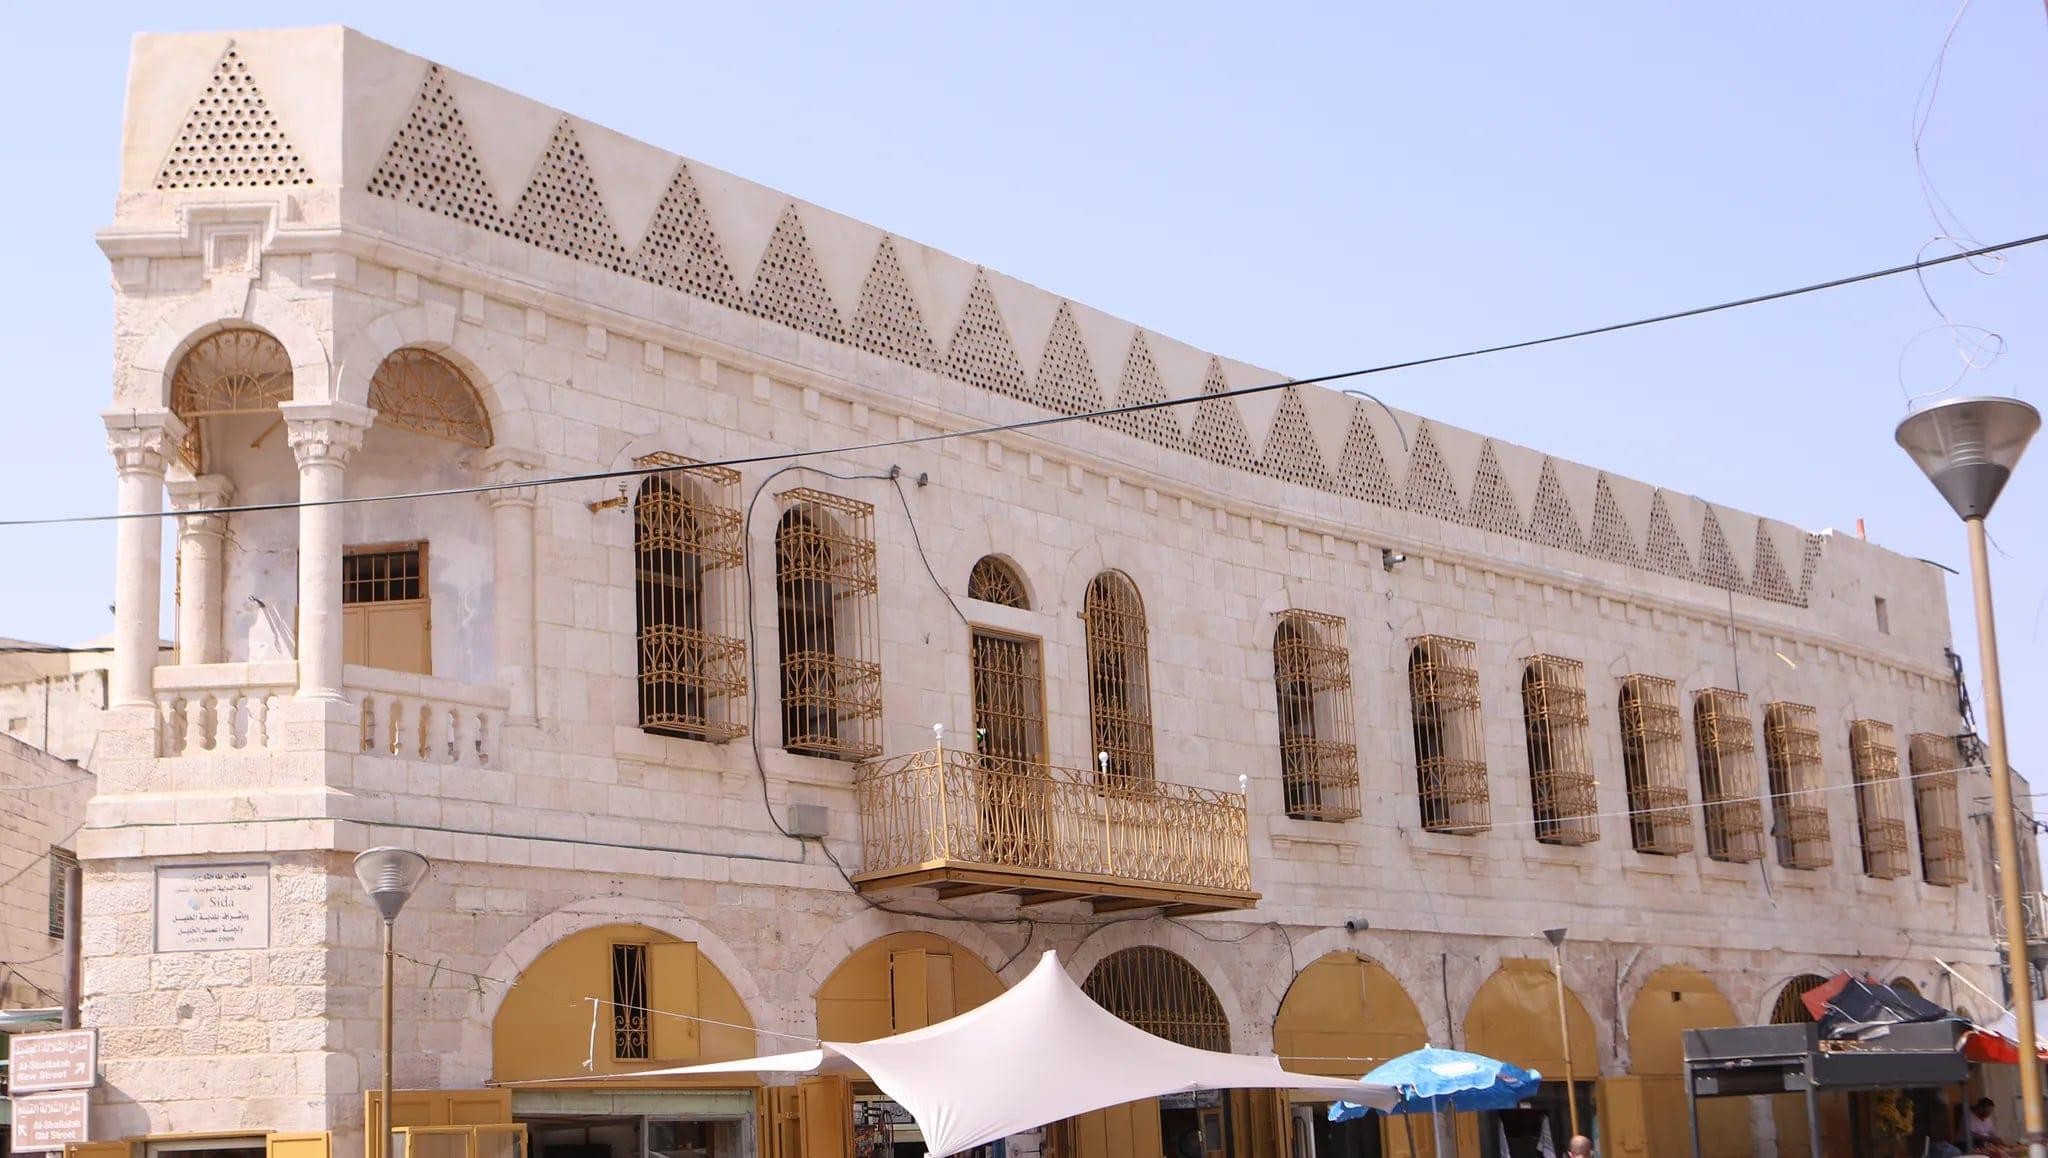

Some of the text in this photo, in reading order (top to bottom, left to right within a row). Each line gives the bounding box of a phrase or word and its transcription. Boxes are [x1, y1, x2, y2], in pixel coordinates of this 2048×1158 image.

[209, 896, 234, 908] Sida
[69, 1038, 88, 1054] شارع
[17, 1070, 67, 1082] New Street
[64, 1100, 81, 1116] شارع
[35, 1130, 76, 1140] Old Street
